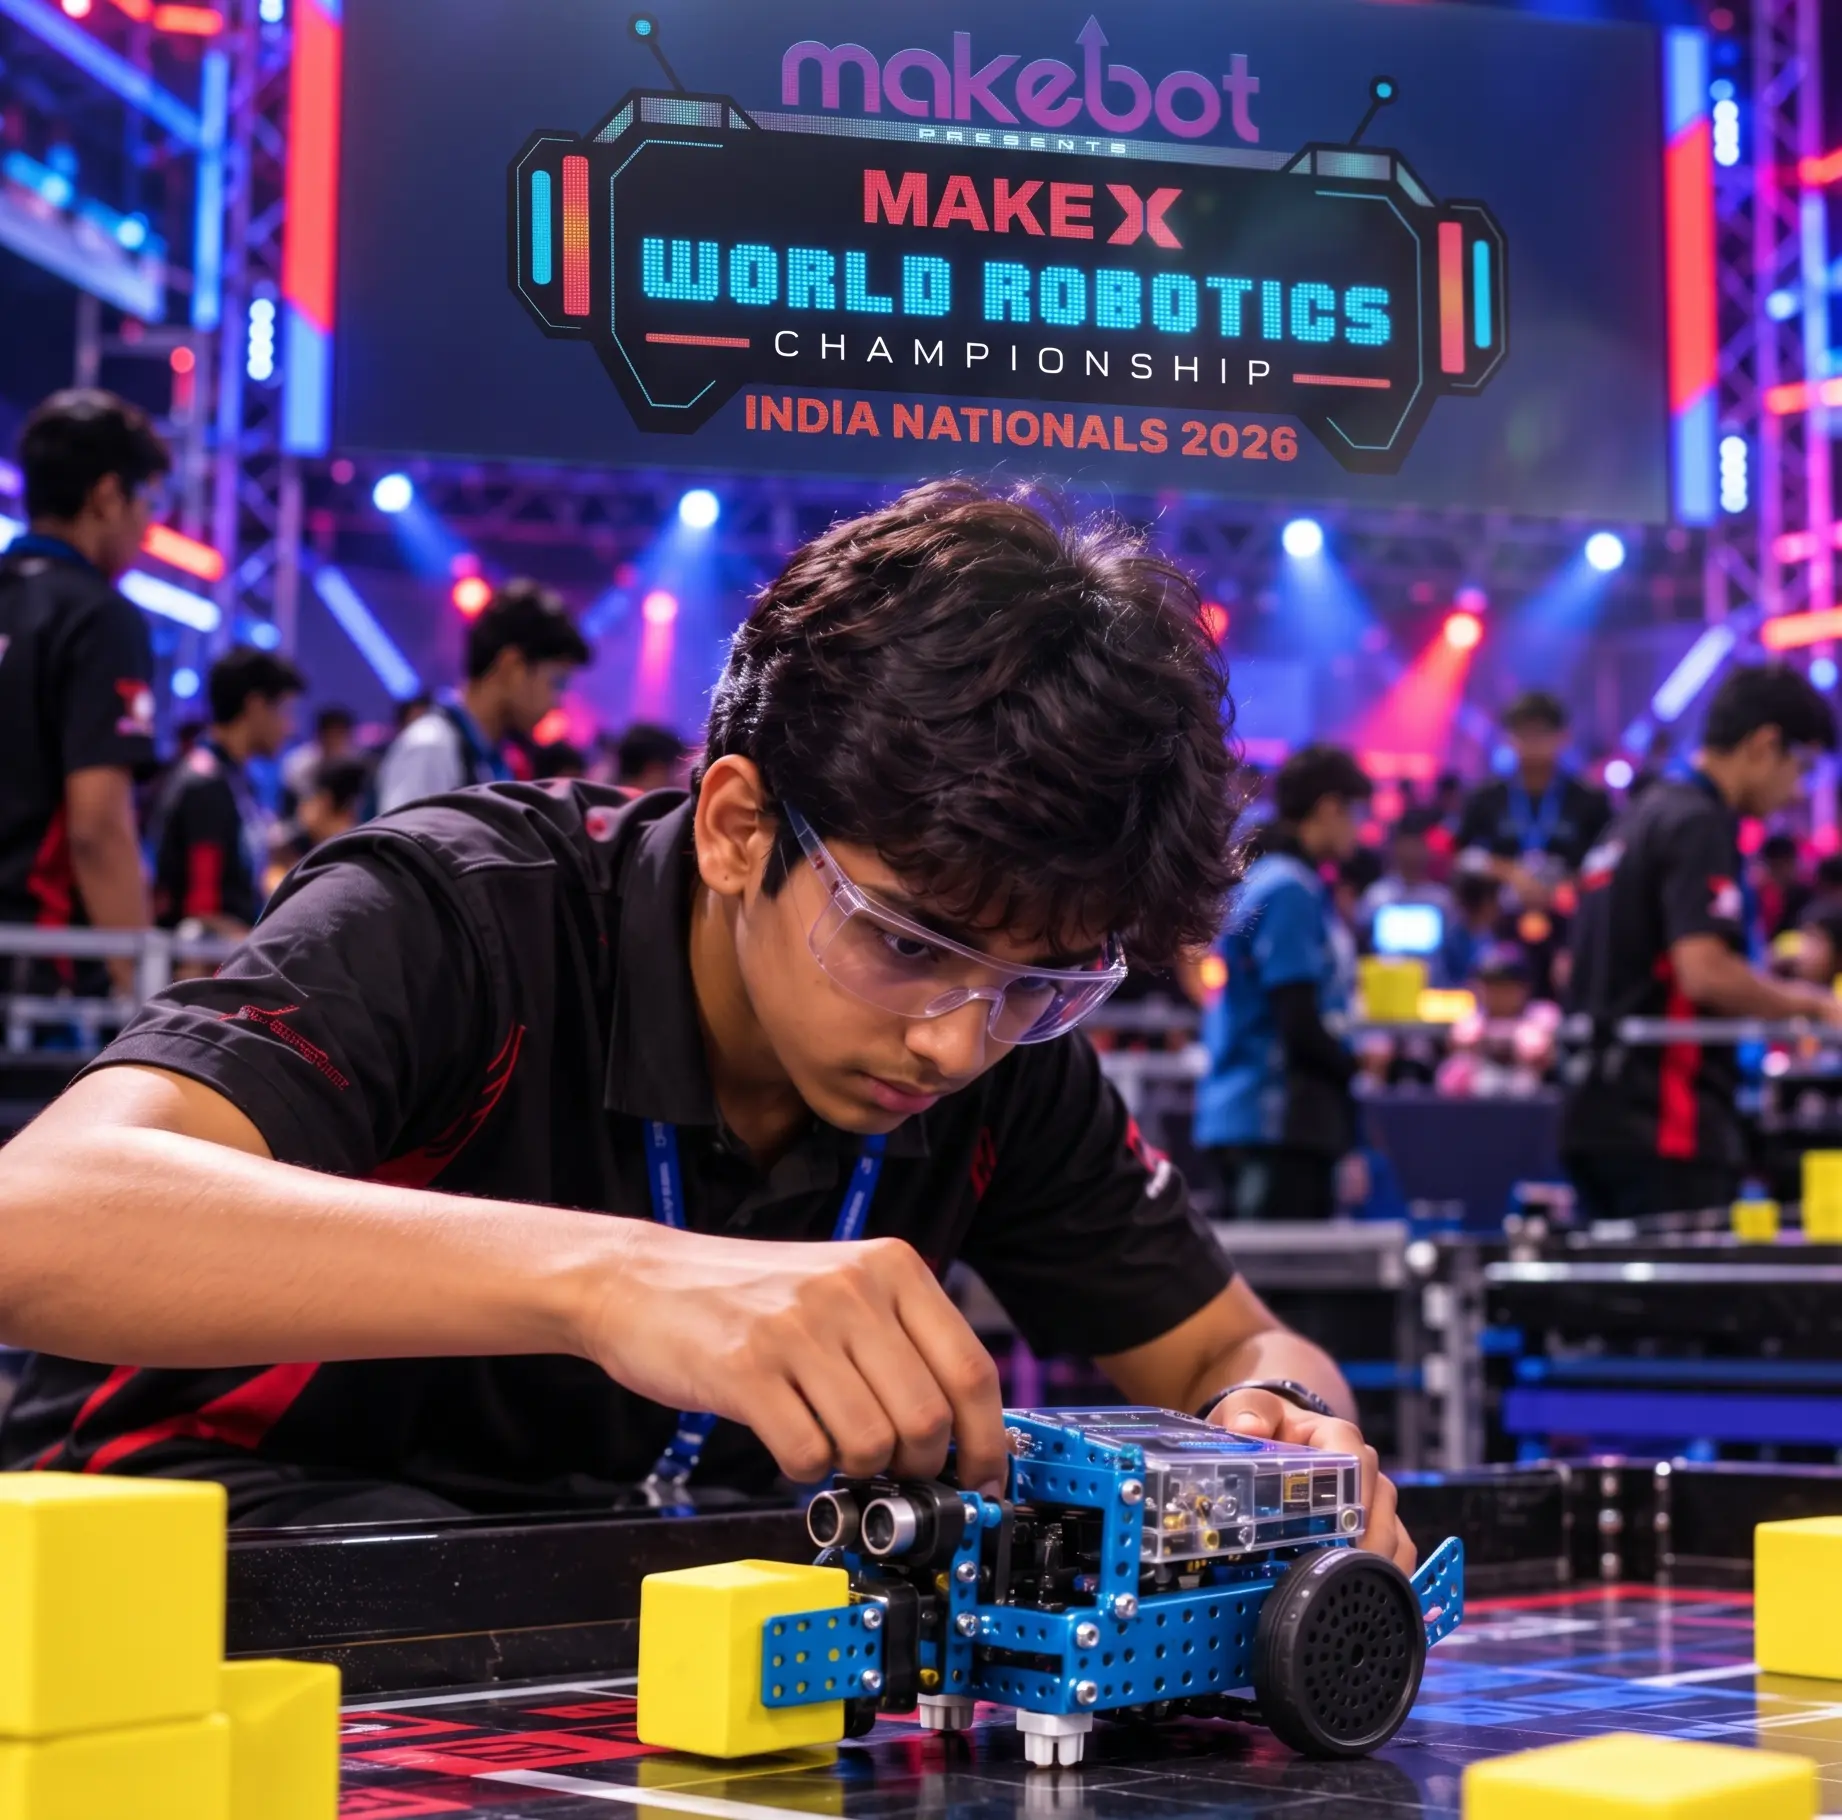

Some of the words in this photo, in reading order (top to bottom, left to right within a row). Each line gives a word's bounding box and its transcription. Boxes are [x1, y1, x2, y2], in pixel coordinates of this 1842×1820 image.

[782, 14, 1260, 143] makebot
[919, 128, 1127, 154] PRESENTS
[643, 237, 951, 316] WORLD
[984, 261, 1391, 346] ROBOTICS
[774, 330, 1271, 386] CHAMPIONSHIP
[745, 394, 883, 437] INDIA
[893, 403, 1168, 454] NATIONALS
[1181, 420, 1298, 462] 2026
